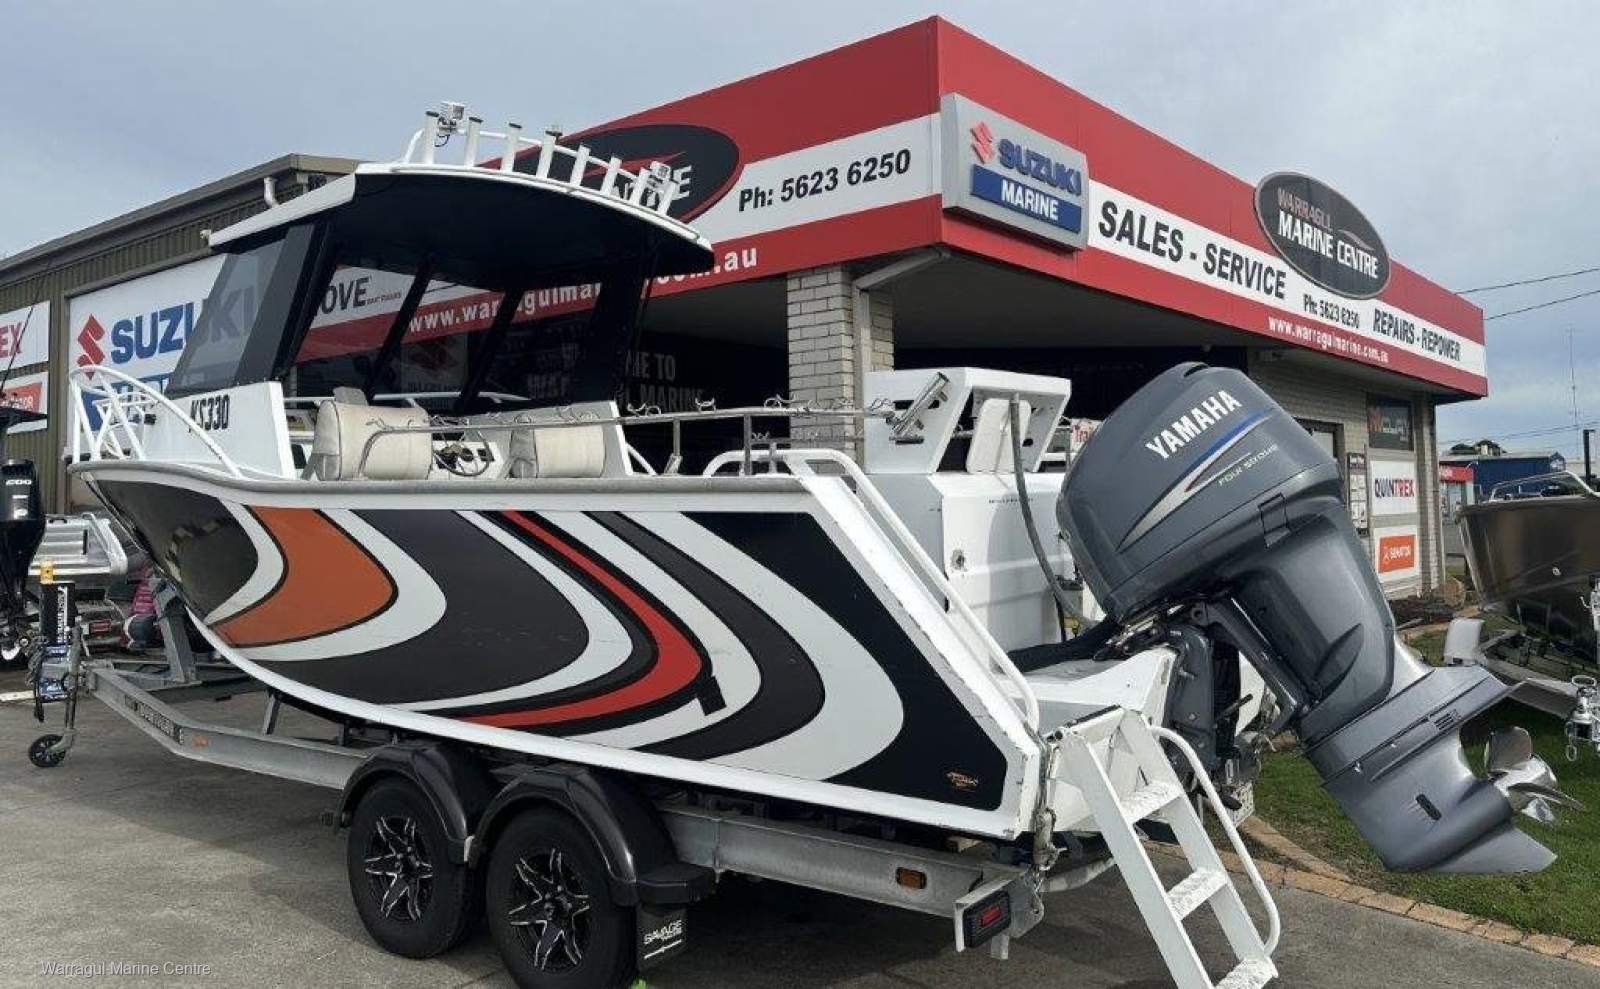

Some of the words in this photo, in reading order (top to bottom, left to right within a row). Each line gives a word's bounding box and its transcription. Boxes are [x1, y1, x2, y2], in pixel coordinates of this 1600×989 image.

[738, 187, 773, 212] Ph:
[780, 167, 839, 202] 5623
[846, 149, 912, 186] 6250
[998, 138, 1082, 197] SUZUKI
[1001, 178, 1059, 221] MARINE
[1098, 200, 1184, 263] SALES
[1202, 243, 1287, 299] SERVICE
[1278, 210, 1334, 259] MARINE
[1337, 240, 1379, 279] CENTRE
[321, 276, 369, 314] OVE
[0, 321, 23, 358] EX
[1372, 308, 1415, 345] REPAIRS
[1421, 327, 1461, 362] REPOWER
[1145, 390, 1243, 460] YAMAHA
[1374, 477, 1415, 498] QUINTREX
